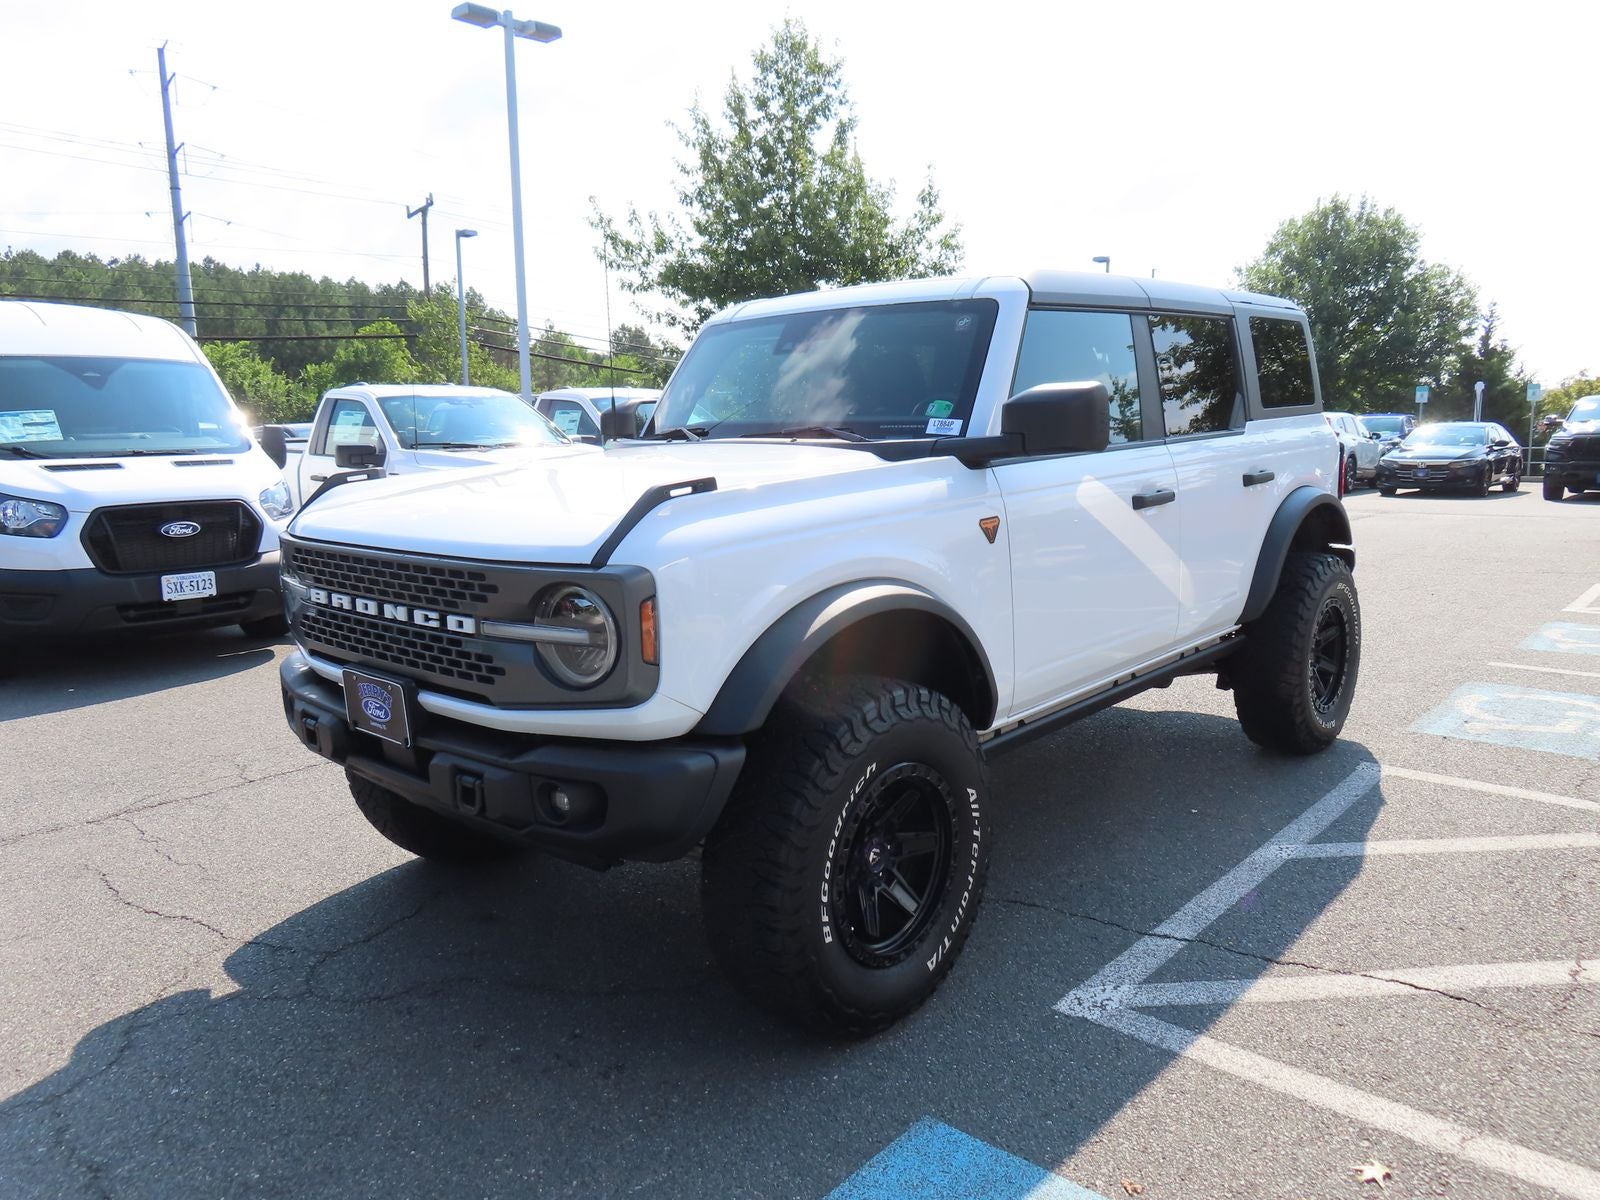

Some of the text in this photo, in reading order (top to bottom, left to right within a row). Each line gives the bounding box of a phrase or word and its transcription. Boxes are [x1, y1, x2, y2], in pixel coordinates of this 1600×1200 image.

[169, 524, 193, 535] Ford
[166, 578, 214, 595] SXK-5123
[310, 587, 477, 634] BRONCO
[1336, 582, 1360, 645] BFGoodrich
[367, 700, 386, 719] Ford
[821, 762, 877, 944] BFGoodrich
[926, 787, 981, 972] All-Terrain T/A
